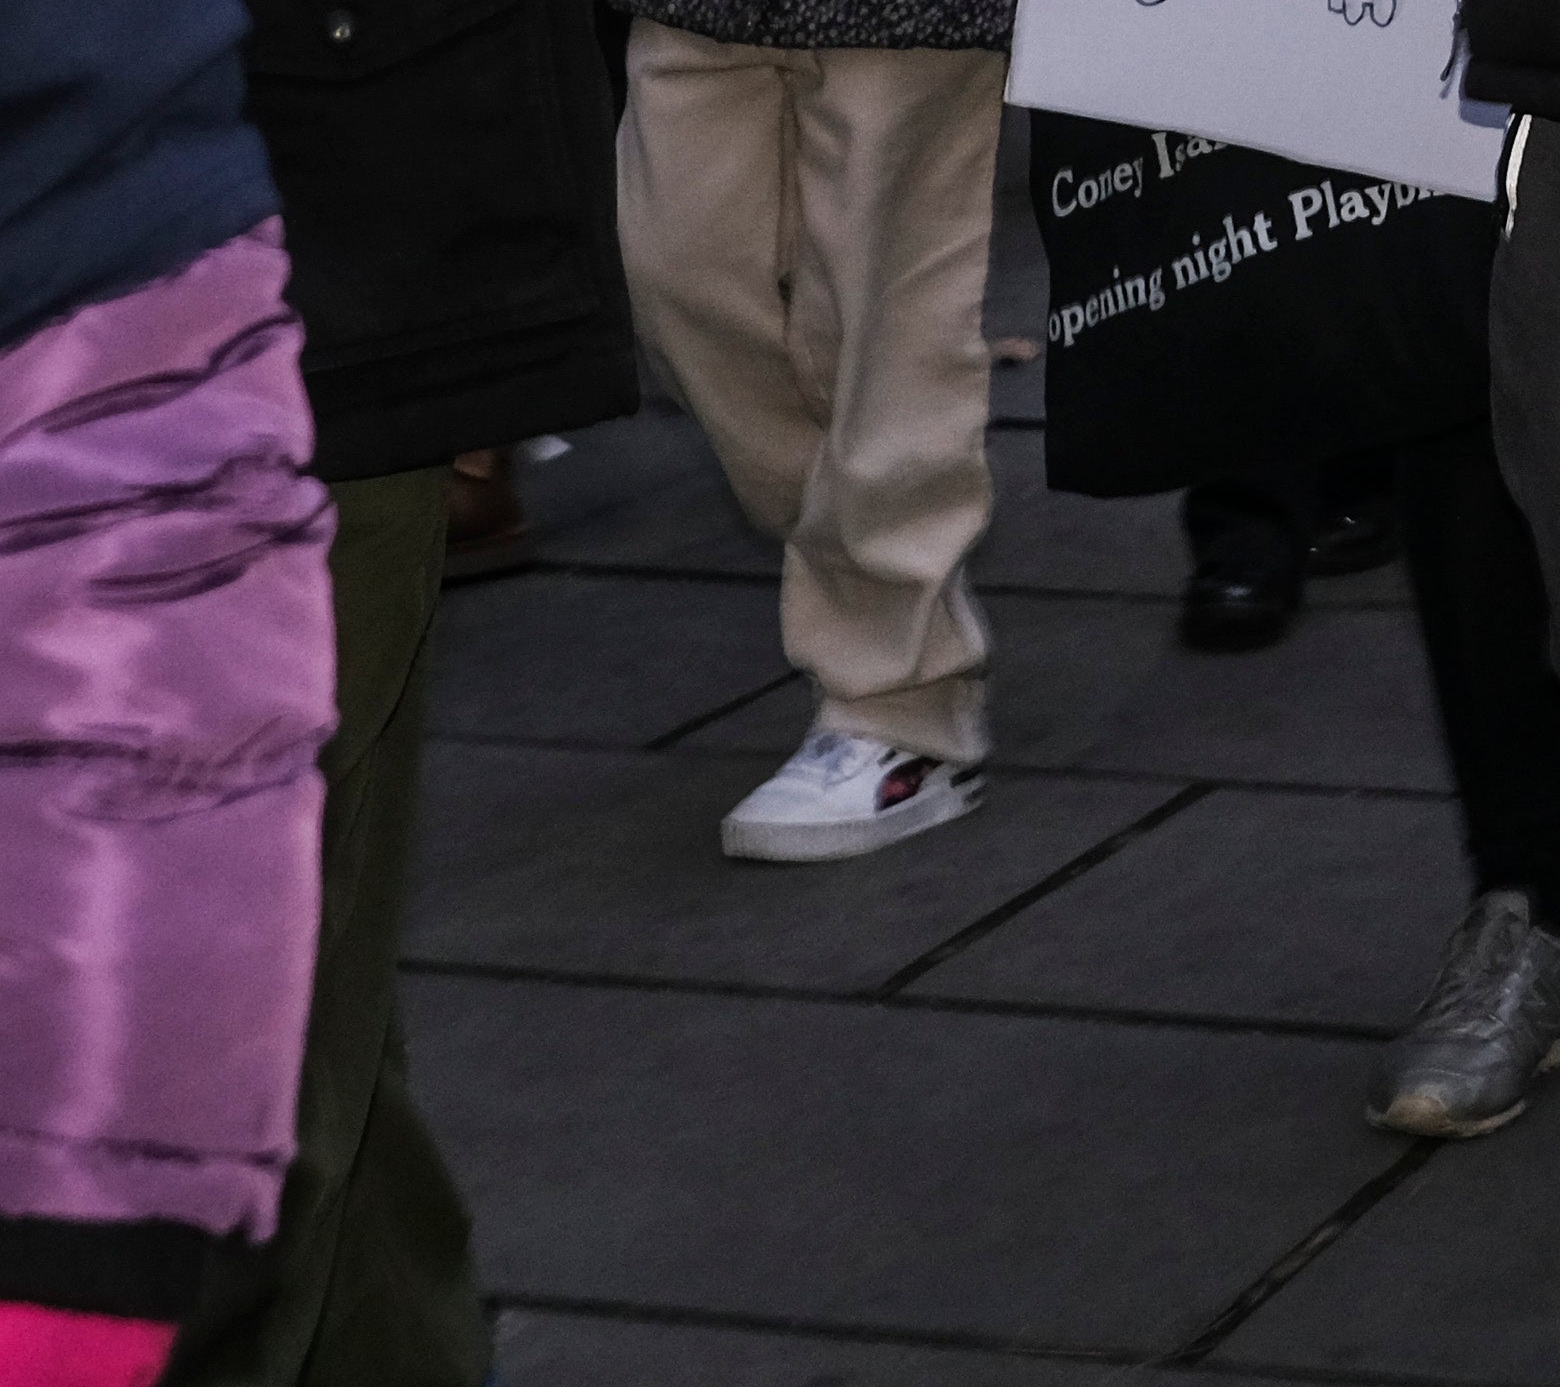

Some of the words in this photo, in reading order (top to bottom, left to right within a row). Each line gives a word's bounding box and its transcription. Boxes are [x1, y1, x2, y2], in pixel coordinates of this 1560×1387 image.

[1051, 156, 1143, 218] Coney
[1049, 264, 1166, 347] opening
[1171, 211, 1279, 290] night
